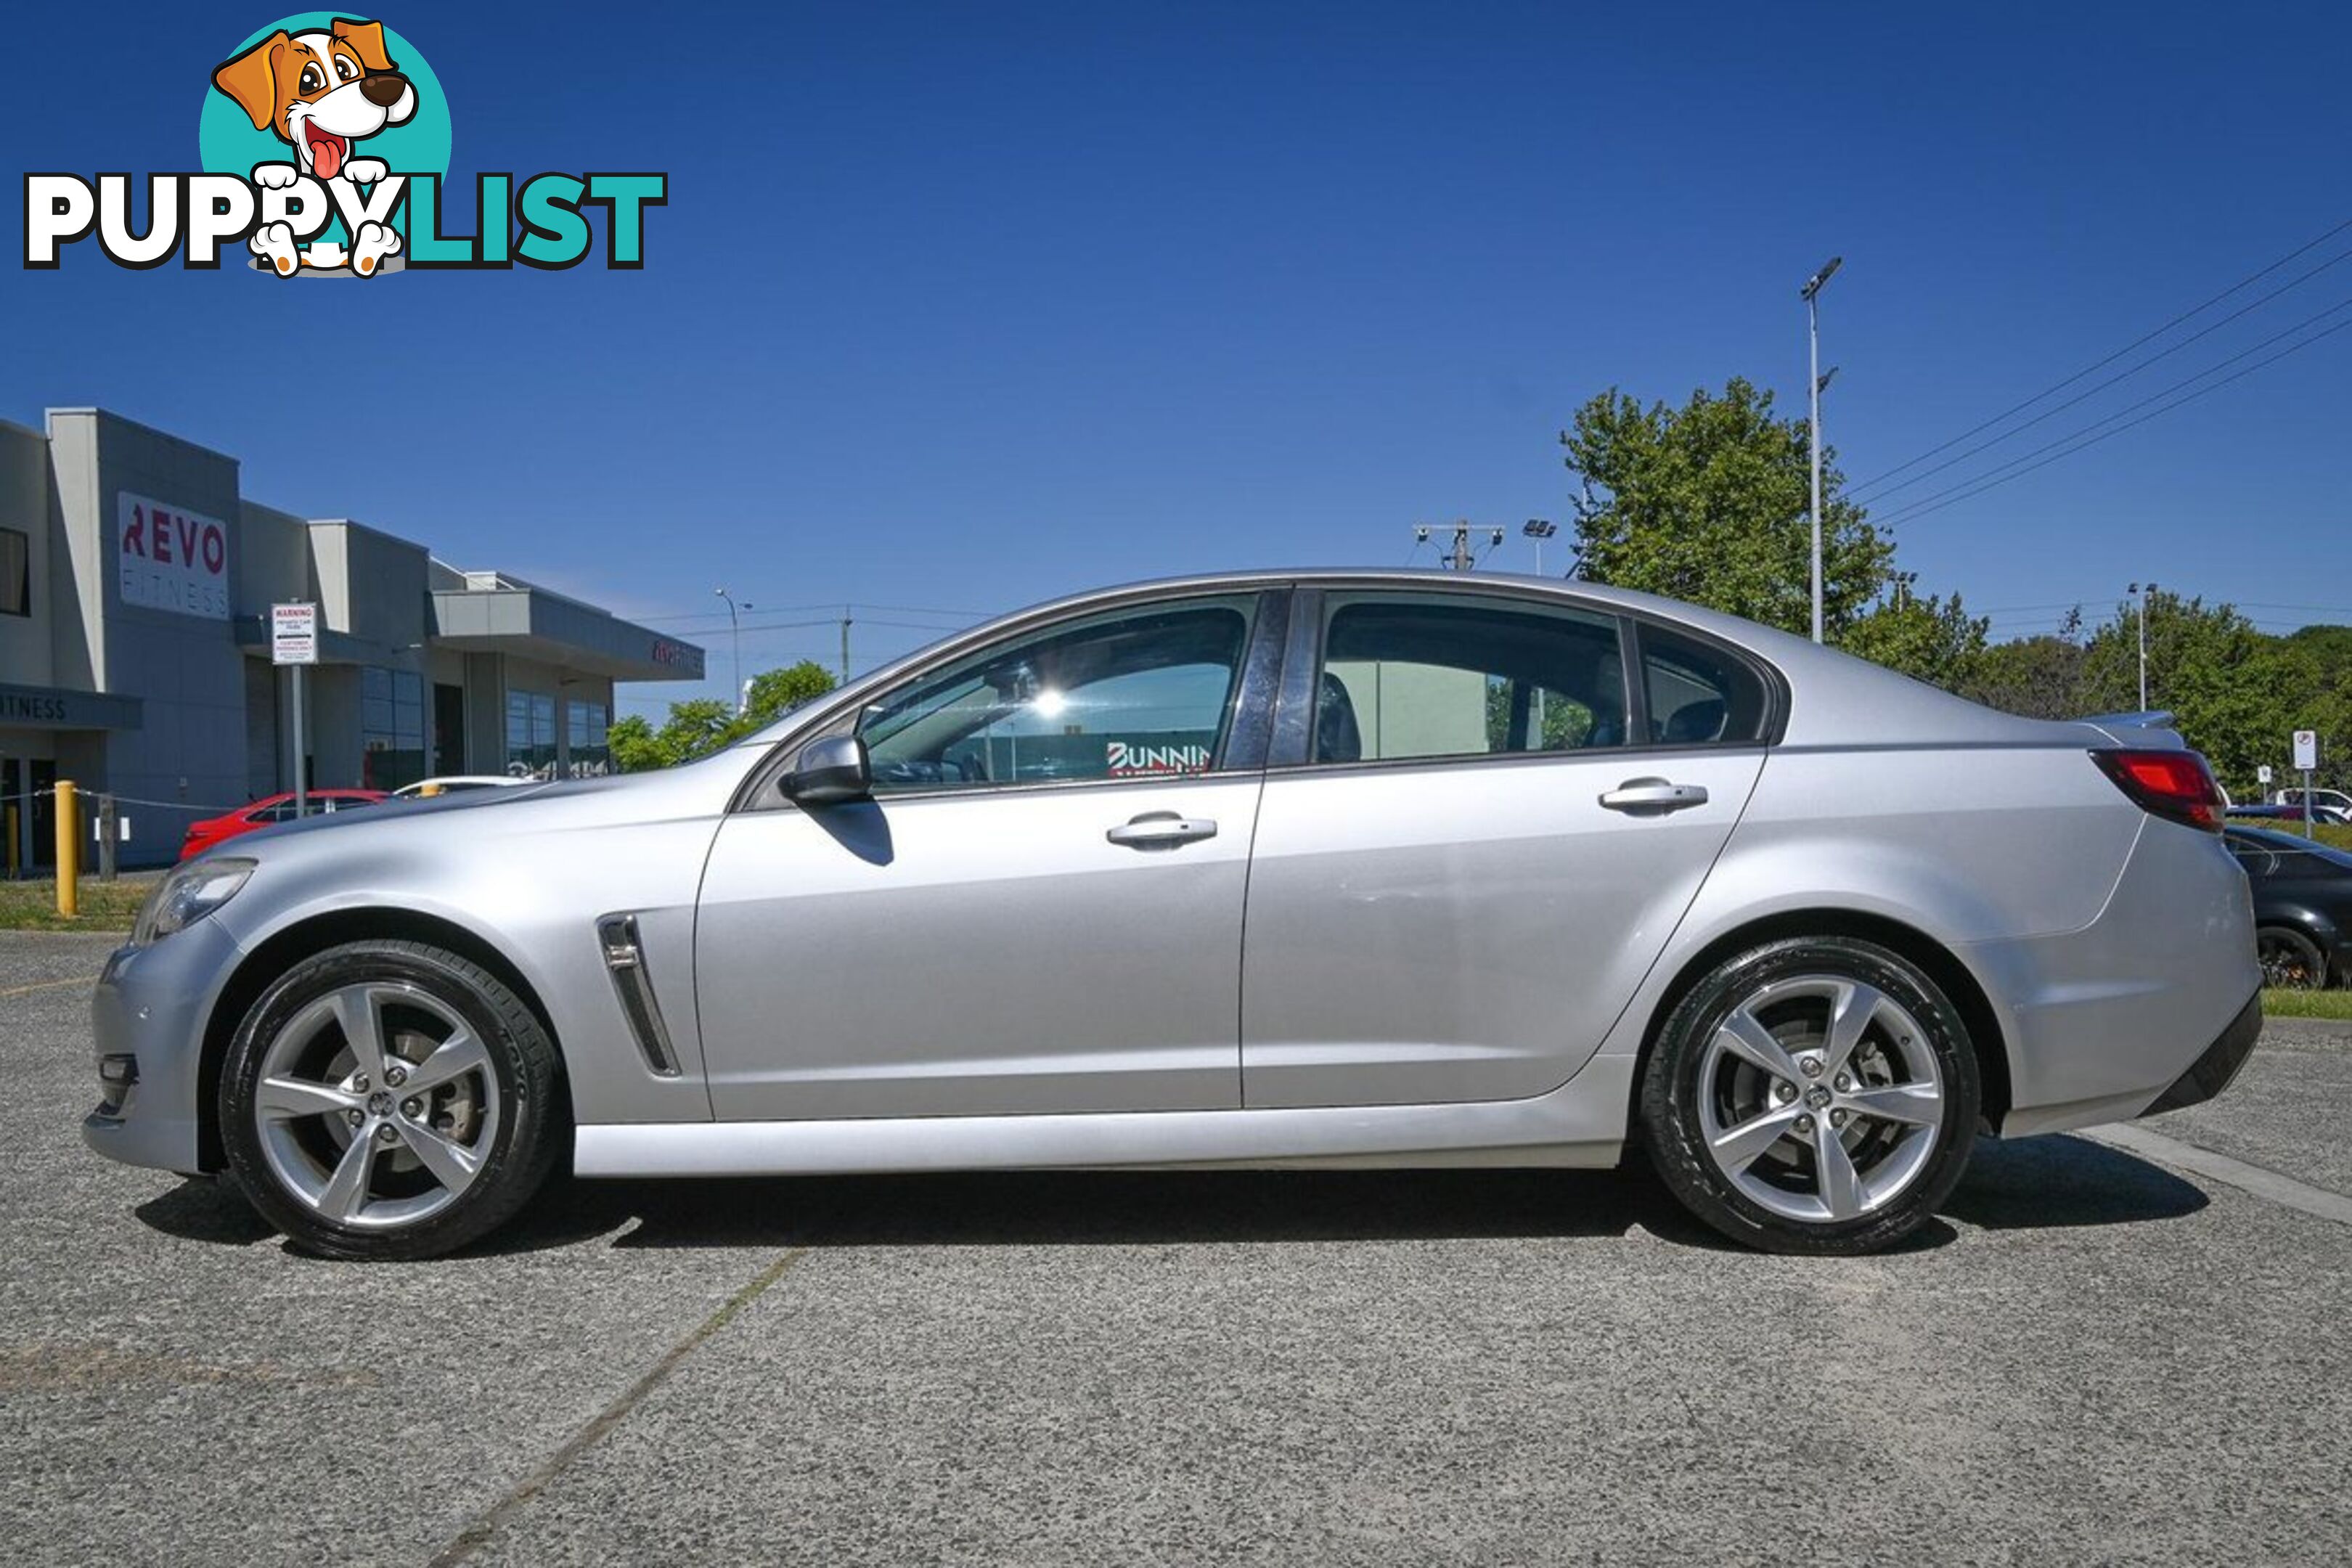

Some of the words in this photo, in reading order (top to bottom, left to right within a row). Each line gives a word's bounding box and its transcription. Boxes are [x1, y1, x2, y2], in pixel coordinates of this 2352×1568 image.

[123, 503, 224, 575] REVO
[123, 568, 227, 615] FITNESS
[276, 608, 312, 617] WARNING
